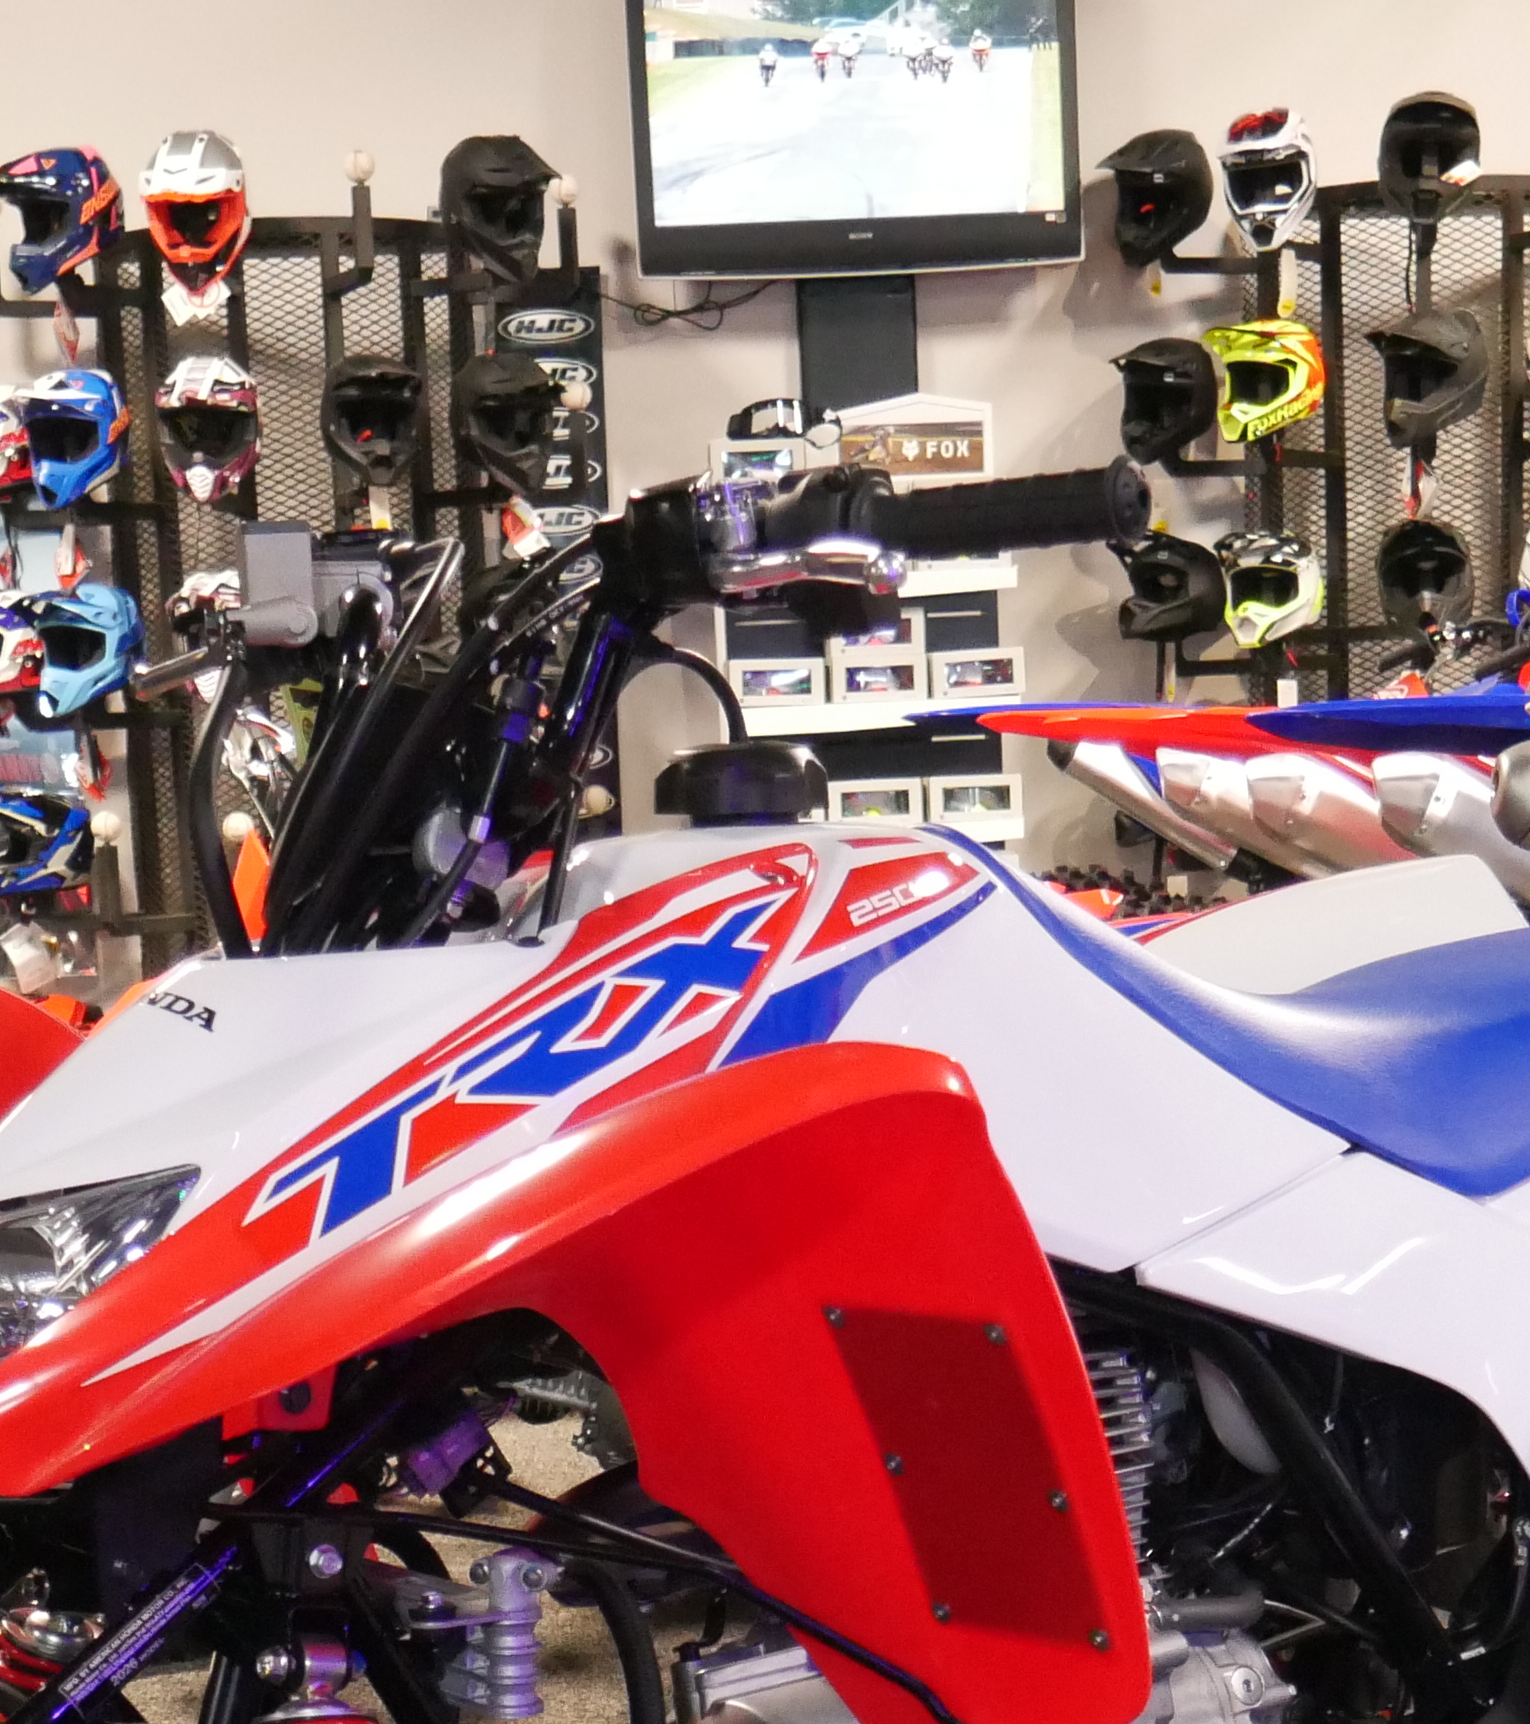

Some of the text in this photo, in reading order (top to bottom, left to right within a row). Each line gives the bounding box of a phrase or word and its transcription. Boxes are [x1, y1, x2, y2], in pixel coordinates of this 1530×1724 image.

[513, 317, 577, 335] HJC
[926, 440, 970, 459] FOX
[259, 897, 783, 1241] TRX
[110, 1657, 139, 1687] 2026
